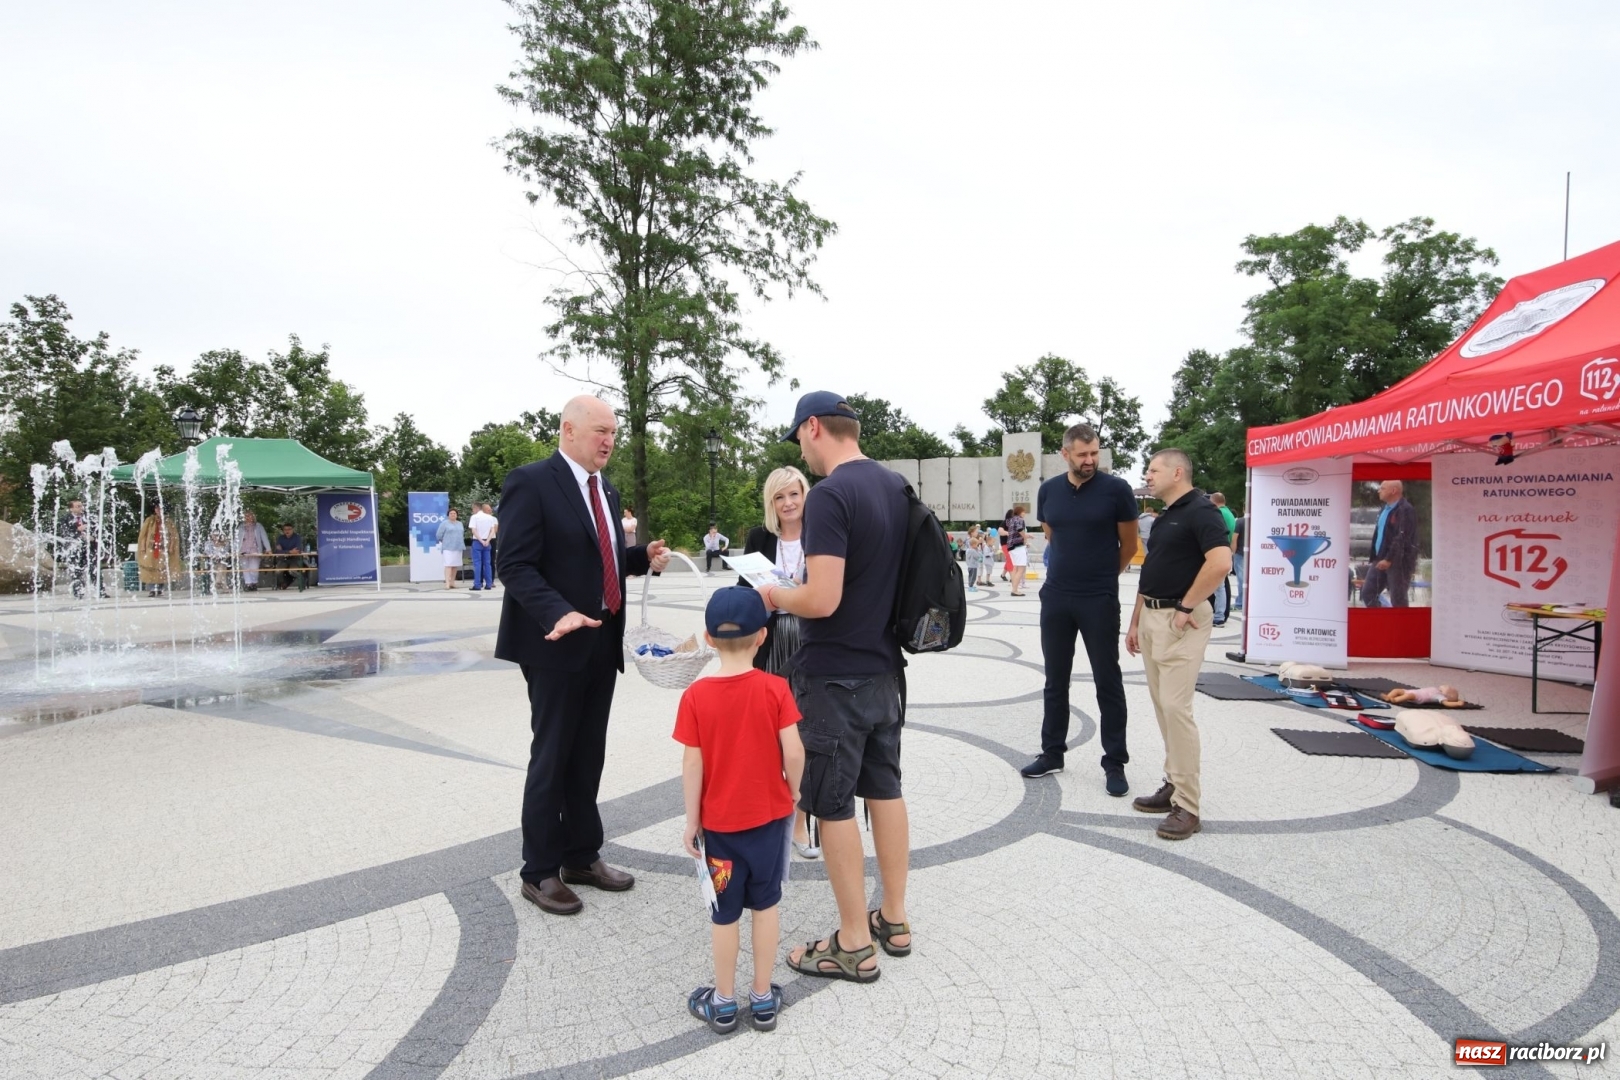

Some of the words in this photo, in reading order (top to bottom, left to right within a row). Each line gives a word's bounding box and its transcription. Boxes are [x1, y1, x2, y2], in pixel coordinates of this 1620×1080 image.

[1586, 367, 1612, 390] 112
[1248, 433, 1294, 456] CENTRUM
[1295, 411, 1402, 449] POWIADAMIANIA
[1406, 379, 1564, 430] RATUNKOWEGO
[1452, 475, 1503, 485] CENTRUM
[1507, 472, 1614, 484] POWIADAMIANIA
[1483, 487, 1576, 498] RATUNKOWEGO
[951, 503, 976, 511] NAUKA
[1271, 498, 1330, 507] POWIADAMIANIE
[413, 512, 445, 524] 500+
[1278, 508, 1322, 517] RATUNKOWE
[1478, 514, 1501, 523] na
[1505, 511, 1579, 524] ratunek
[1271, 527, 1285, 536] 997
[1287, 523, 1309, 538] 112
[1314, 558, 1337, 569] KTO?
[1495, 544, 1549, 573] 112
[1261, 567, 1285, 576] KIEDY?
[1289, 590, 1304, 599] CPR
[1262, 627, 1276, 636] 112
[1294, 627, 1306, 635] CPR
[1307, 628, 1337, 637] KATOWICE
